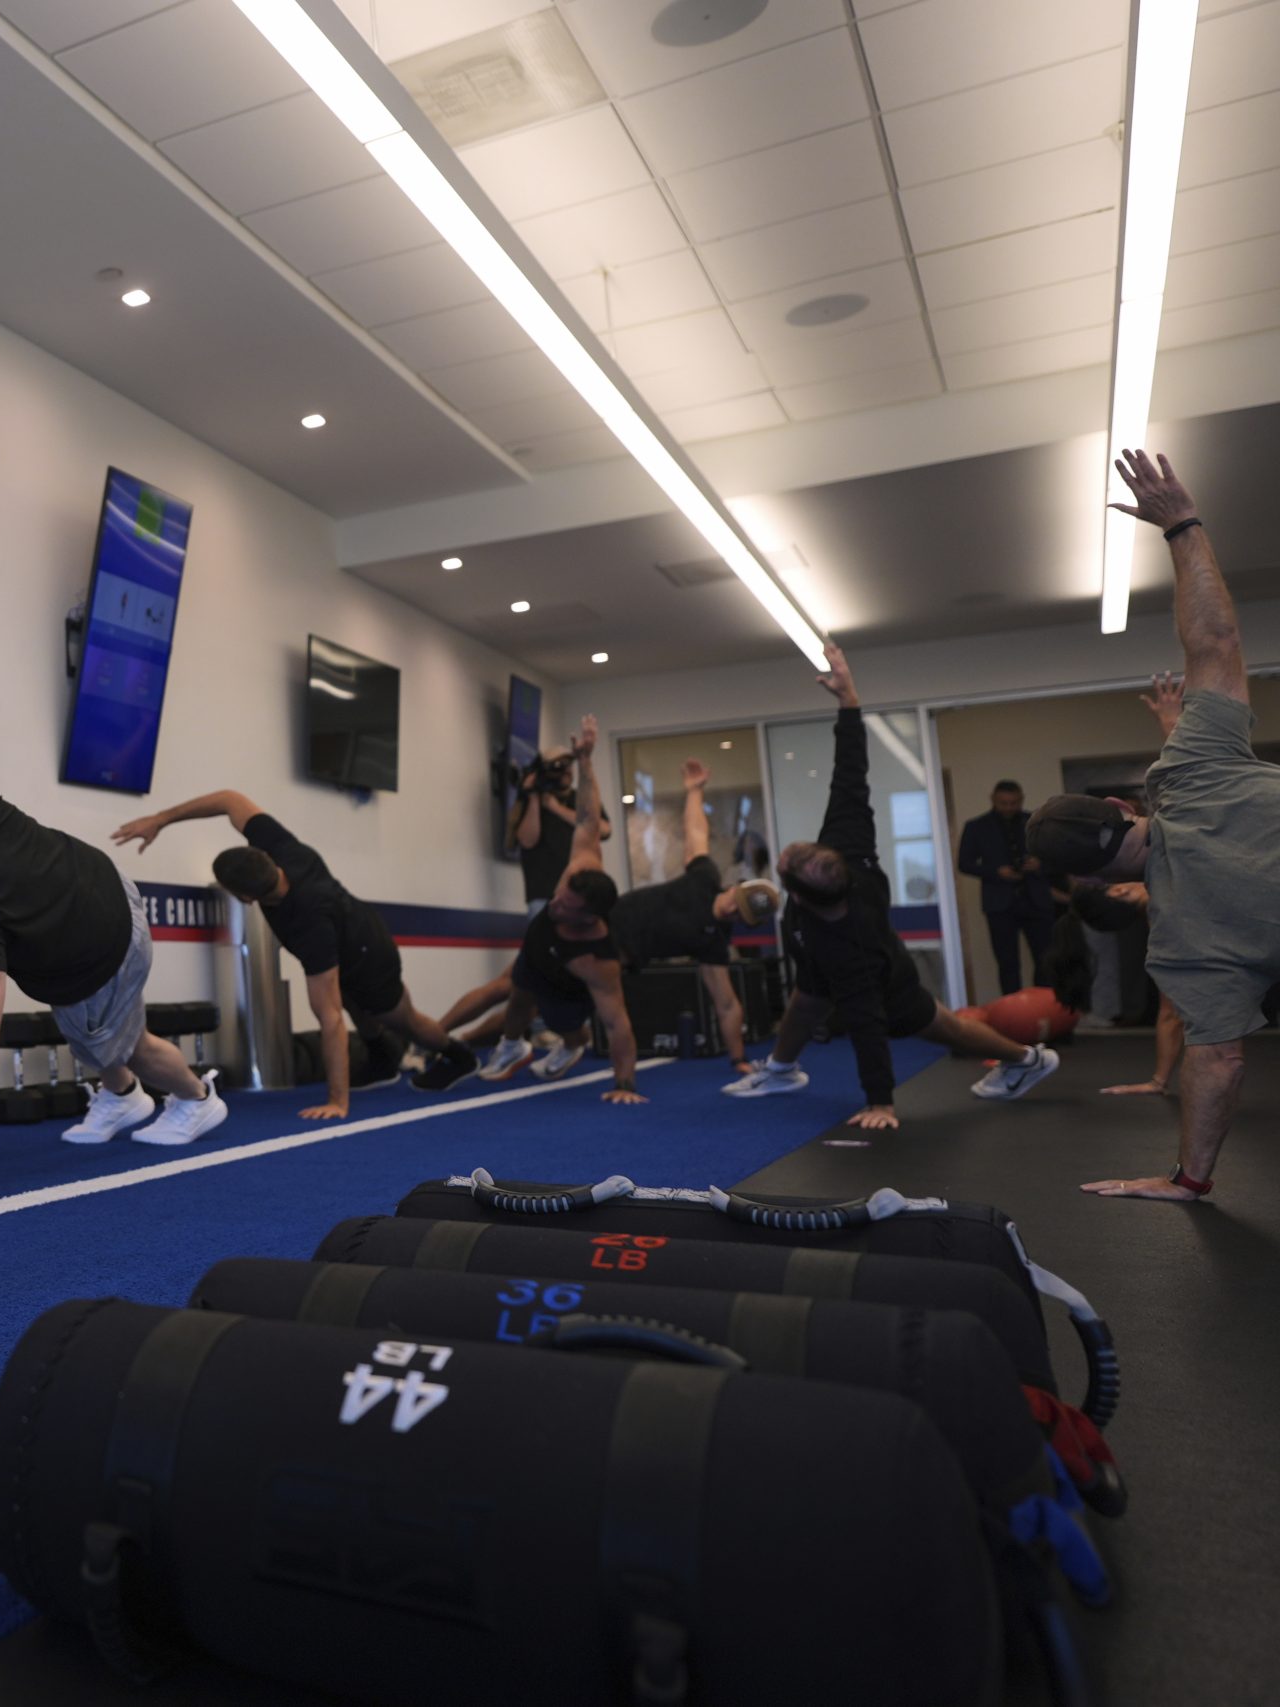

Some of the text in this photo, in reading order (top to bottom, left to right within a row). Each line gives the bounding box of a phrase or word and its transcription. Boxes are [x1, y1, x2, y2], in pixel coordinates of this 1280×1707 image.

[591, 1248, 648, 1271] LB
[496, 1279, 585, 1311] 36
[372, 1341, 453, 1371] LB
[339, 1363, 449, 1433] 44
